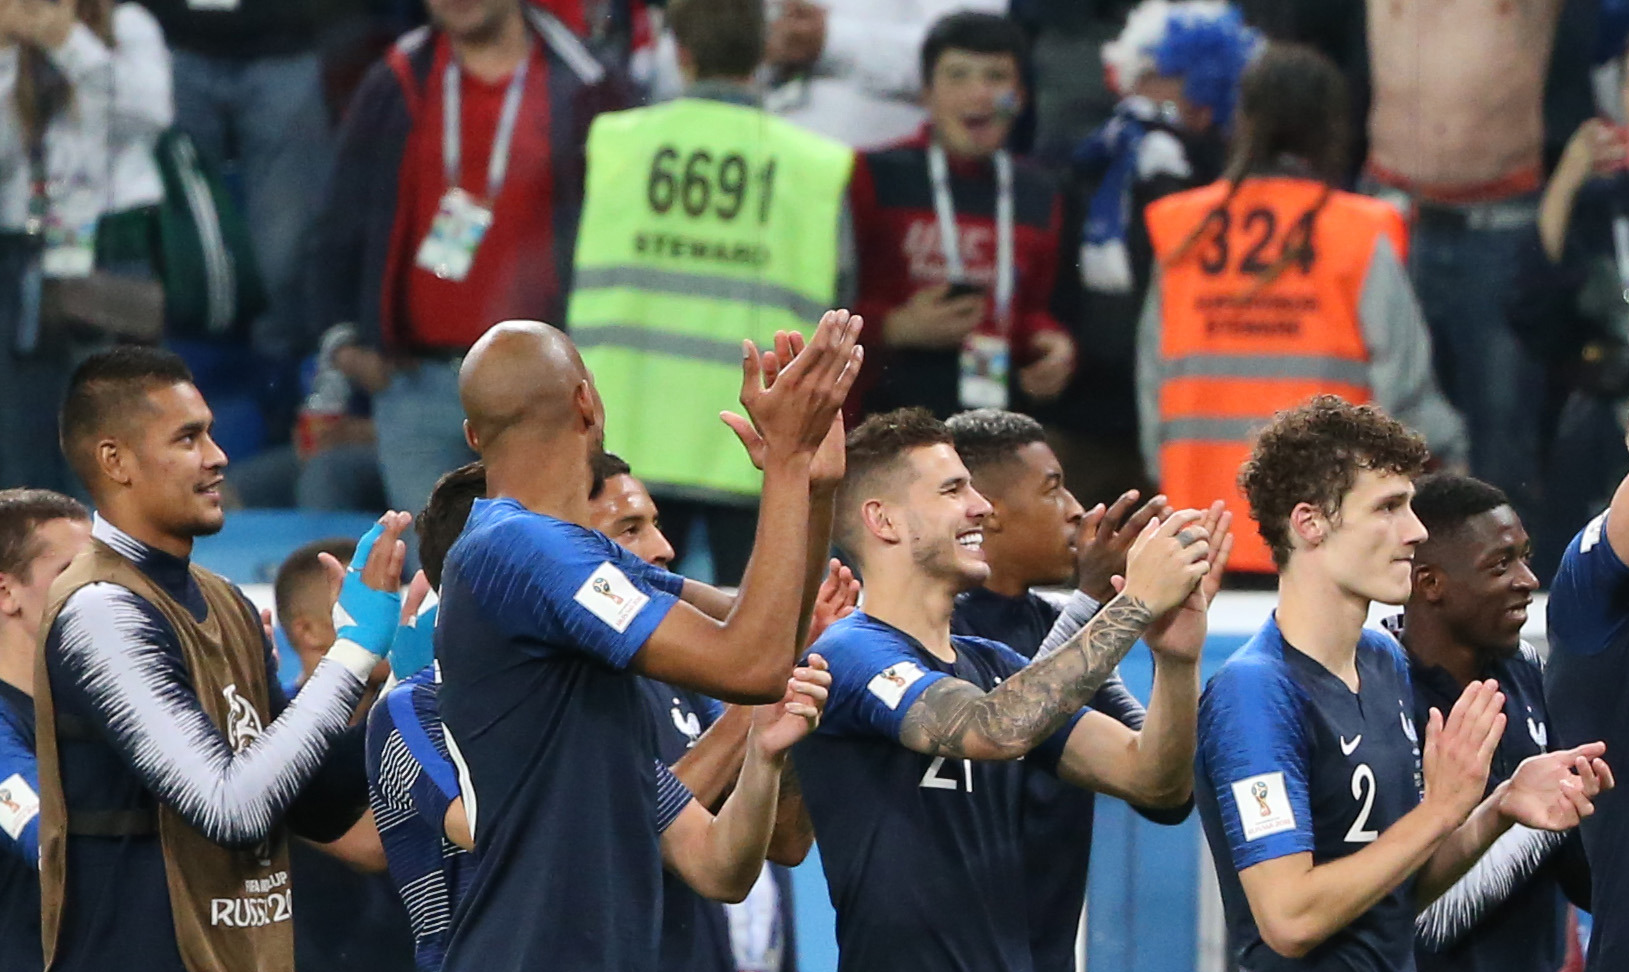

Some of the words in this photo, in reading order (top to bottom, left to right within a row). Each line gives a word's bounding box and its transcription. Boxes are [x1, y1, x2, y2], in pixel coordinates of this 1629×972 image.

[647, 143, 777, 224] 6691
[1199, 206, 1316, 275] 324
[1343, 763, 1379, 843] 2
